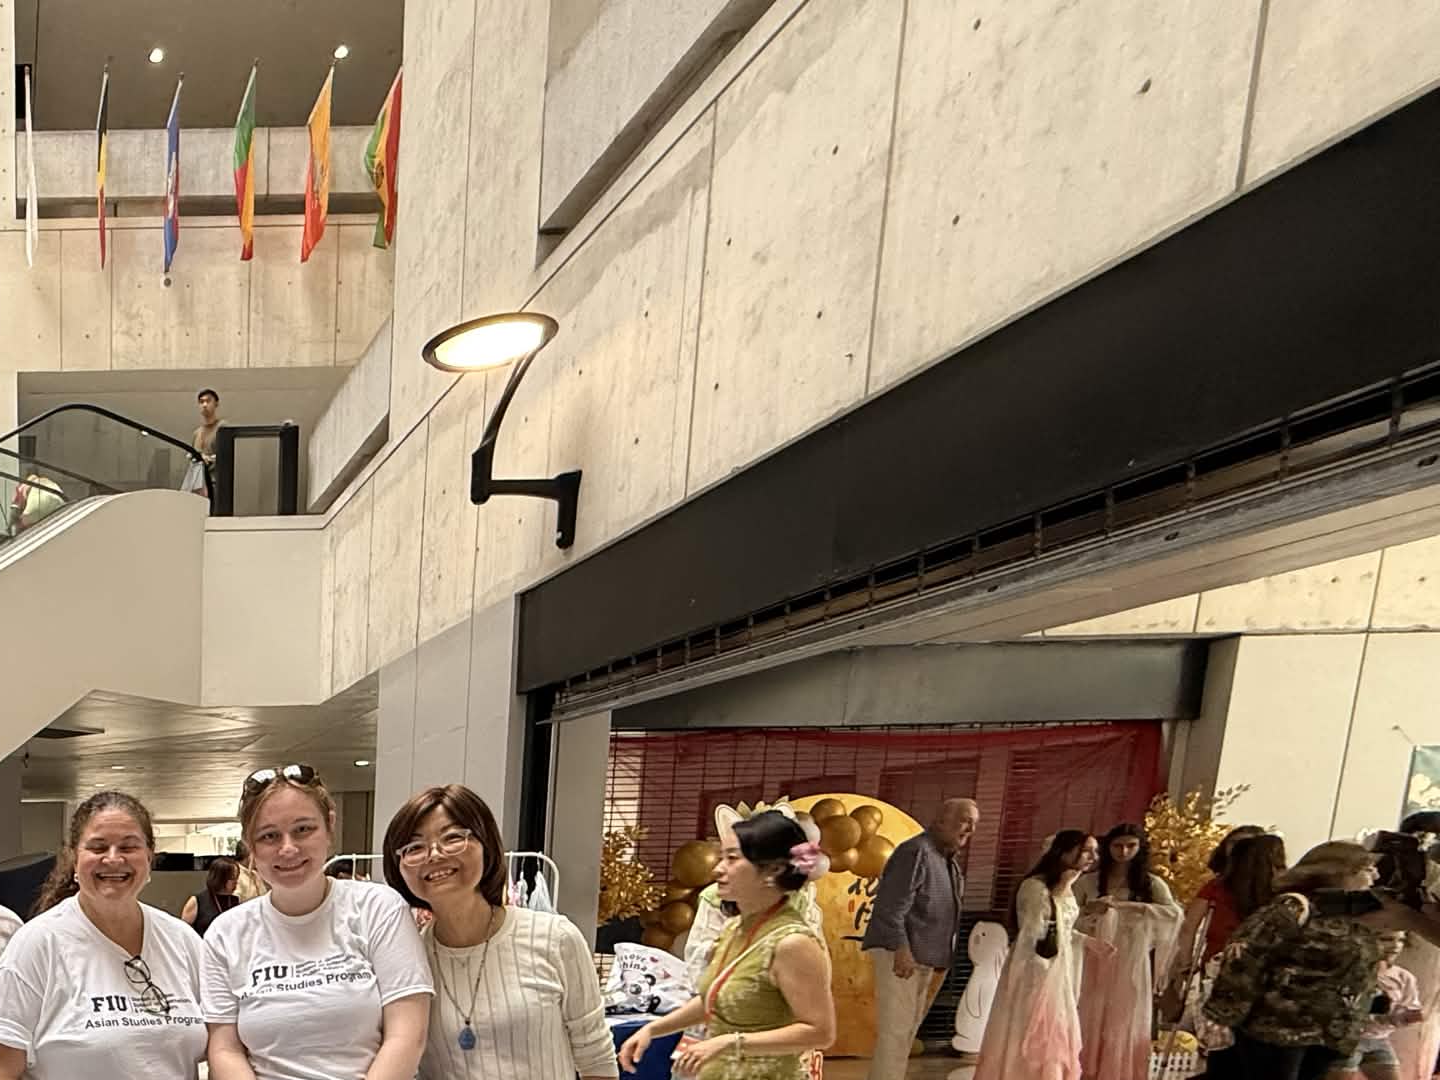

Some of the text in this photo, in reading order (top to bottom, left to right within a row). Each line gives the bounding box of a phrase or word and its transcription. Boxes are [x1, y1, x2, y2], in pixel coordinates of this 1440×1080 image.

[251, 965, 289, 987] FIU
[276, 979, 323, 992] Studies
[91, 995, 128, 1013] FIU
[85, 1018, 119, 1029] Asian
[122, 1016, 163, 1026] Studies
